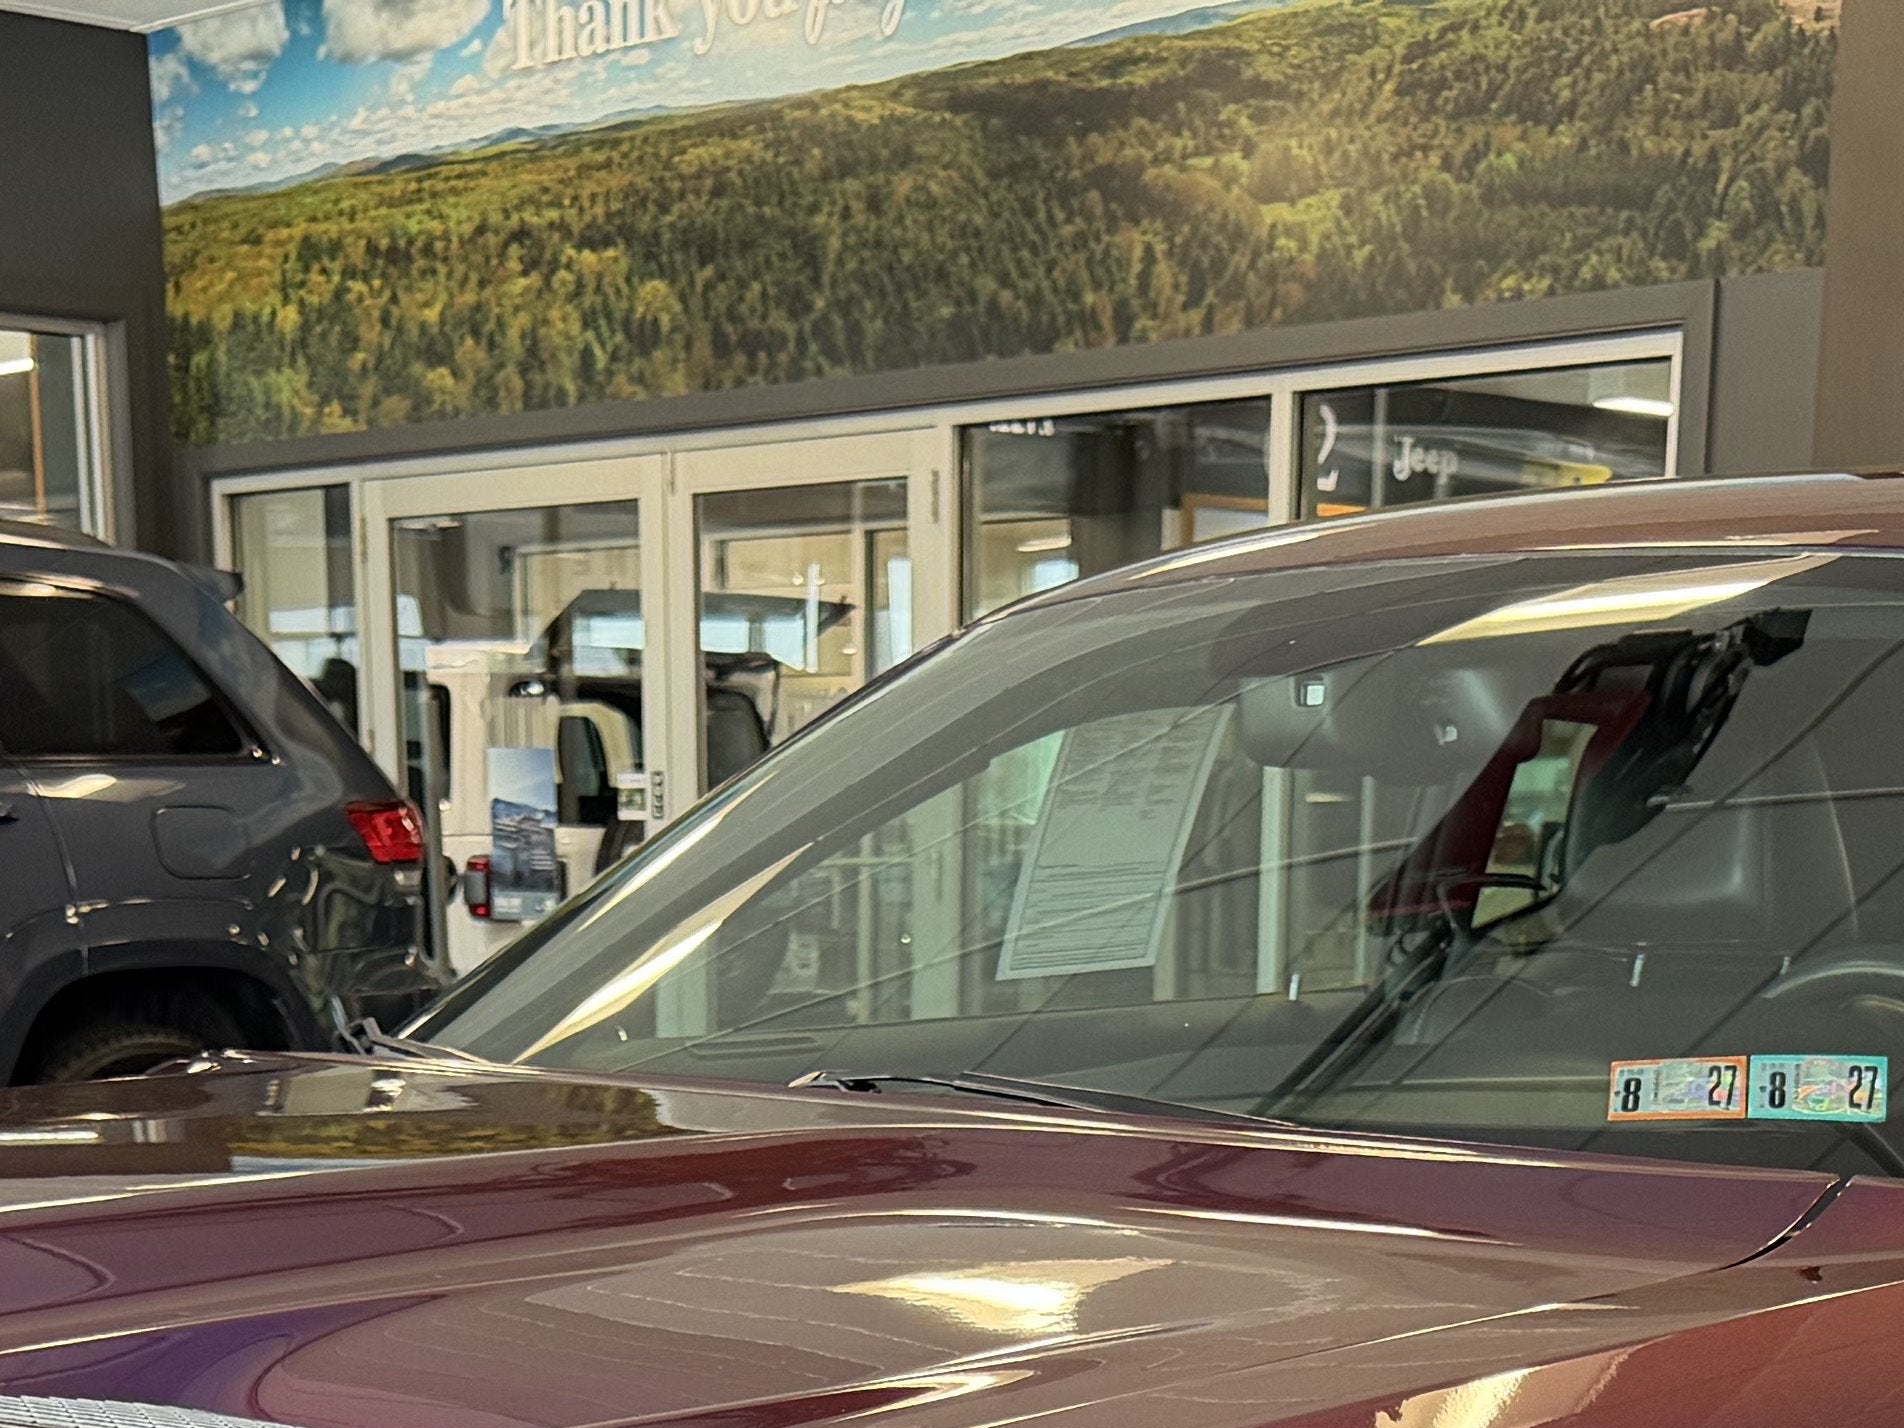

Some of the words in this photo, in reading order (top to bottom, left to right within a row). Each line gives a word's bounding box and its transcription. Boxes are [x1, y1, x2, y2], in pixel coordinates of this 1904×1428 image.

[500, 0, 680, 70] Thank
[1392, 436, 1458, 492] Jeep
[1620, 1077, 1642, 1113] 8
[1708, 1064, 1738, 1111] 27
[1767, 1071, 1786, 1110] 8
[1848, 1064, 1879, 1112] 27
